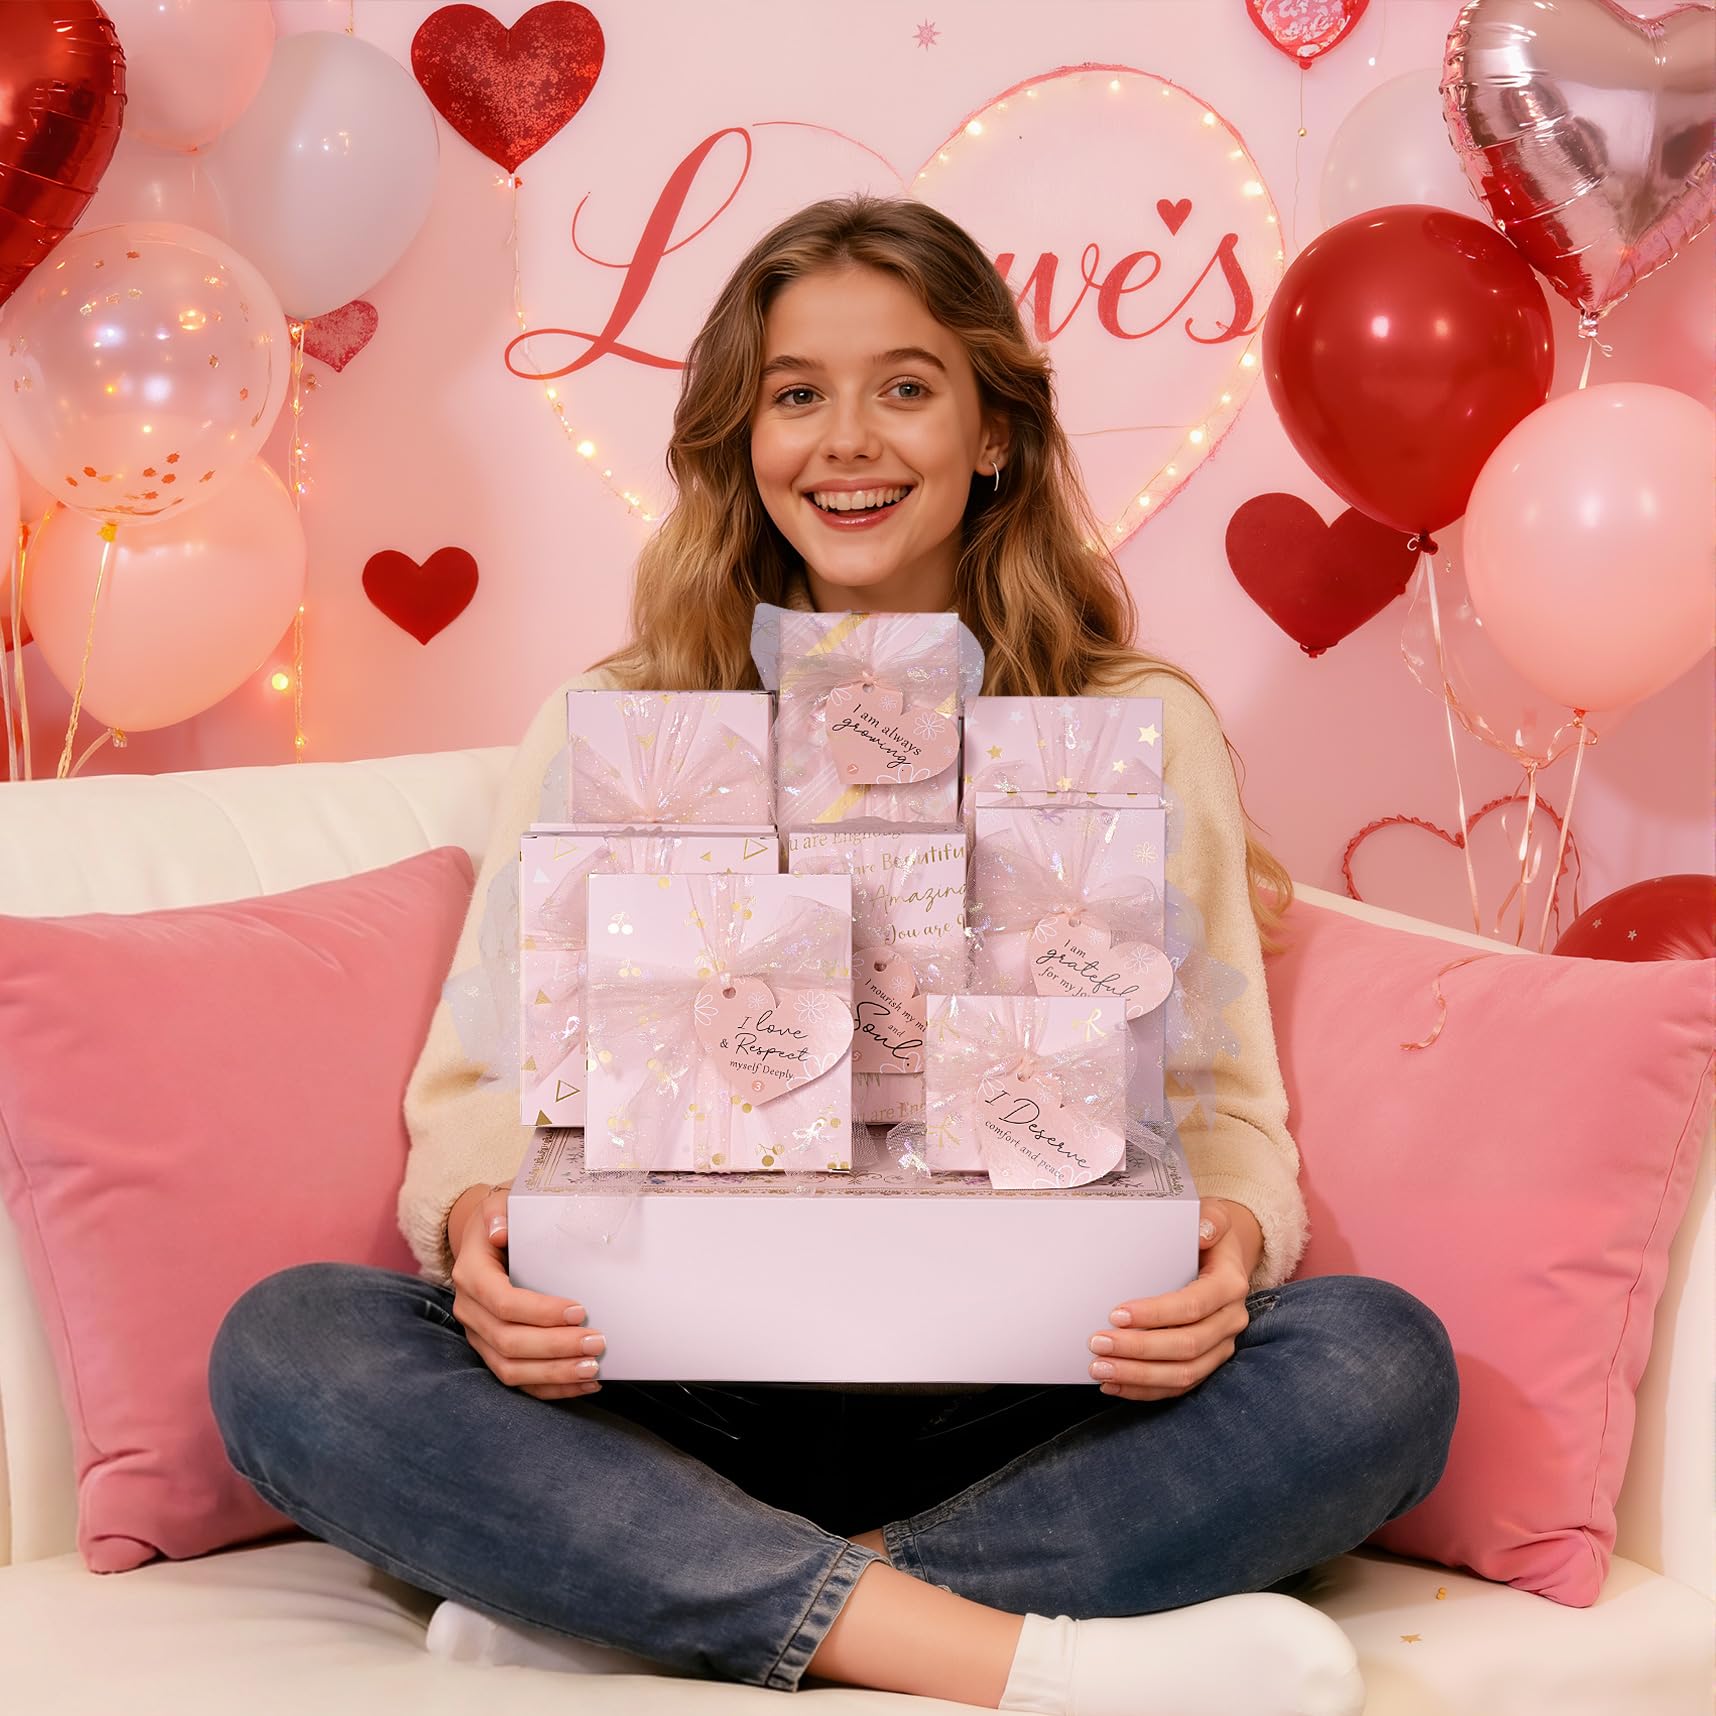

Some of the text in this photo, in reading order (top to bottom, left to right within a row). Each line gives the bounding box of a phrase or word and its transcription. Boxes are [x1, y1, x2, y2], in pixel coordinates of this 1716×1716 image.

[853, 704, 922, 756] I am always
[803, 834, 828, 849] are
[924, 923, 951, 938] are
[1064, 939, 1087, 959] I am
[1036, 949, 1140, 1001] grateful
[1038, 966, 1059, 980] for
[1060, 979, 1076, 993] my
[864, 978, 871, 987] I
[870, 984, 902, 1012] nourish
[902, 1010, 915, 1023] my
[737, 1010, 808, 1039] I love
[888, 1024, 907, 1038] and
[720, 1032, 810, 1062] & Respect
[730, 1059, 762, 1074] myself
[985, 1090, 1090, 1169] I Deserve
[985, 1119, 1021, 1148] comfort
[1020, 1145, 1040, 1162] and
